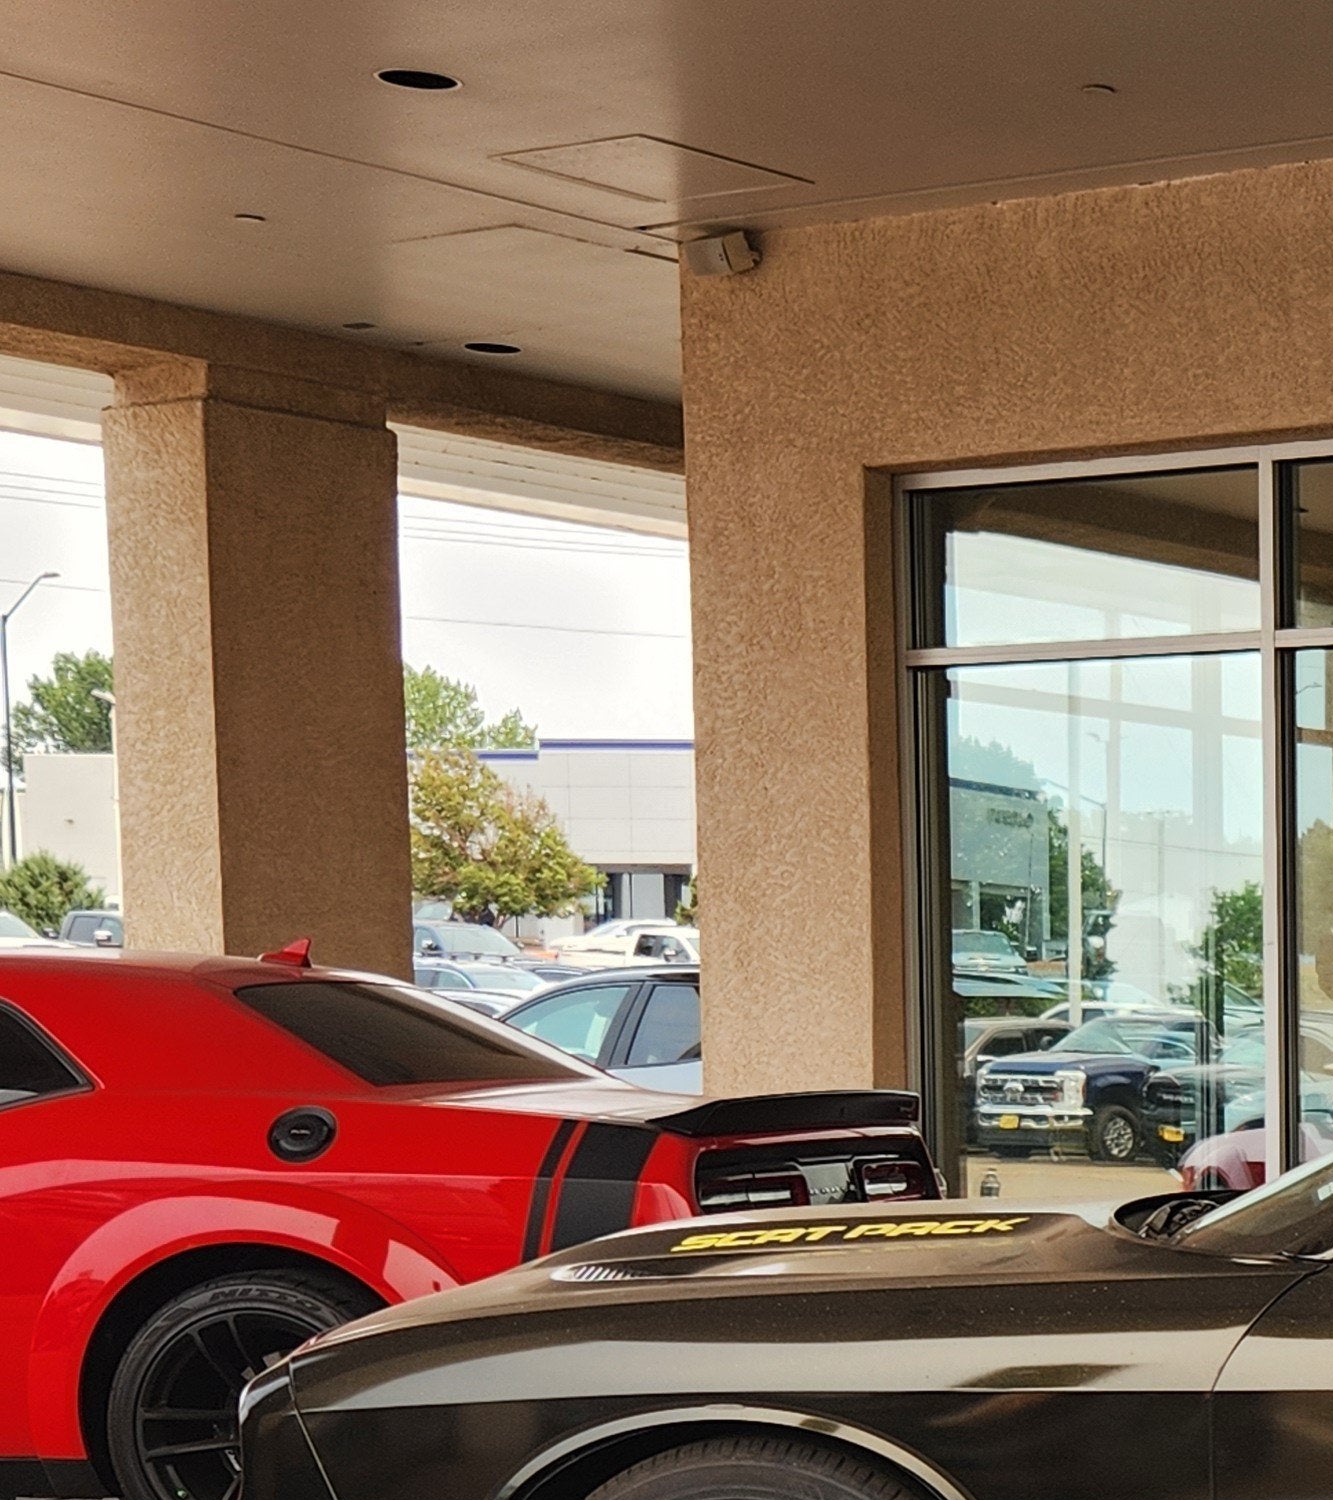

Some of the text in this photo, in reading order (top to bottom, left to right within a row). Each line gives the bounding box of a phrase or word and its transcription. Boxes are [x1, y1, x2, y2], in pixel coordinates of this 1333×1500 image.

[670, 1217, 1030, 1252] SCAT PACK
[209, 1287, 322, 1312] NITTO
